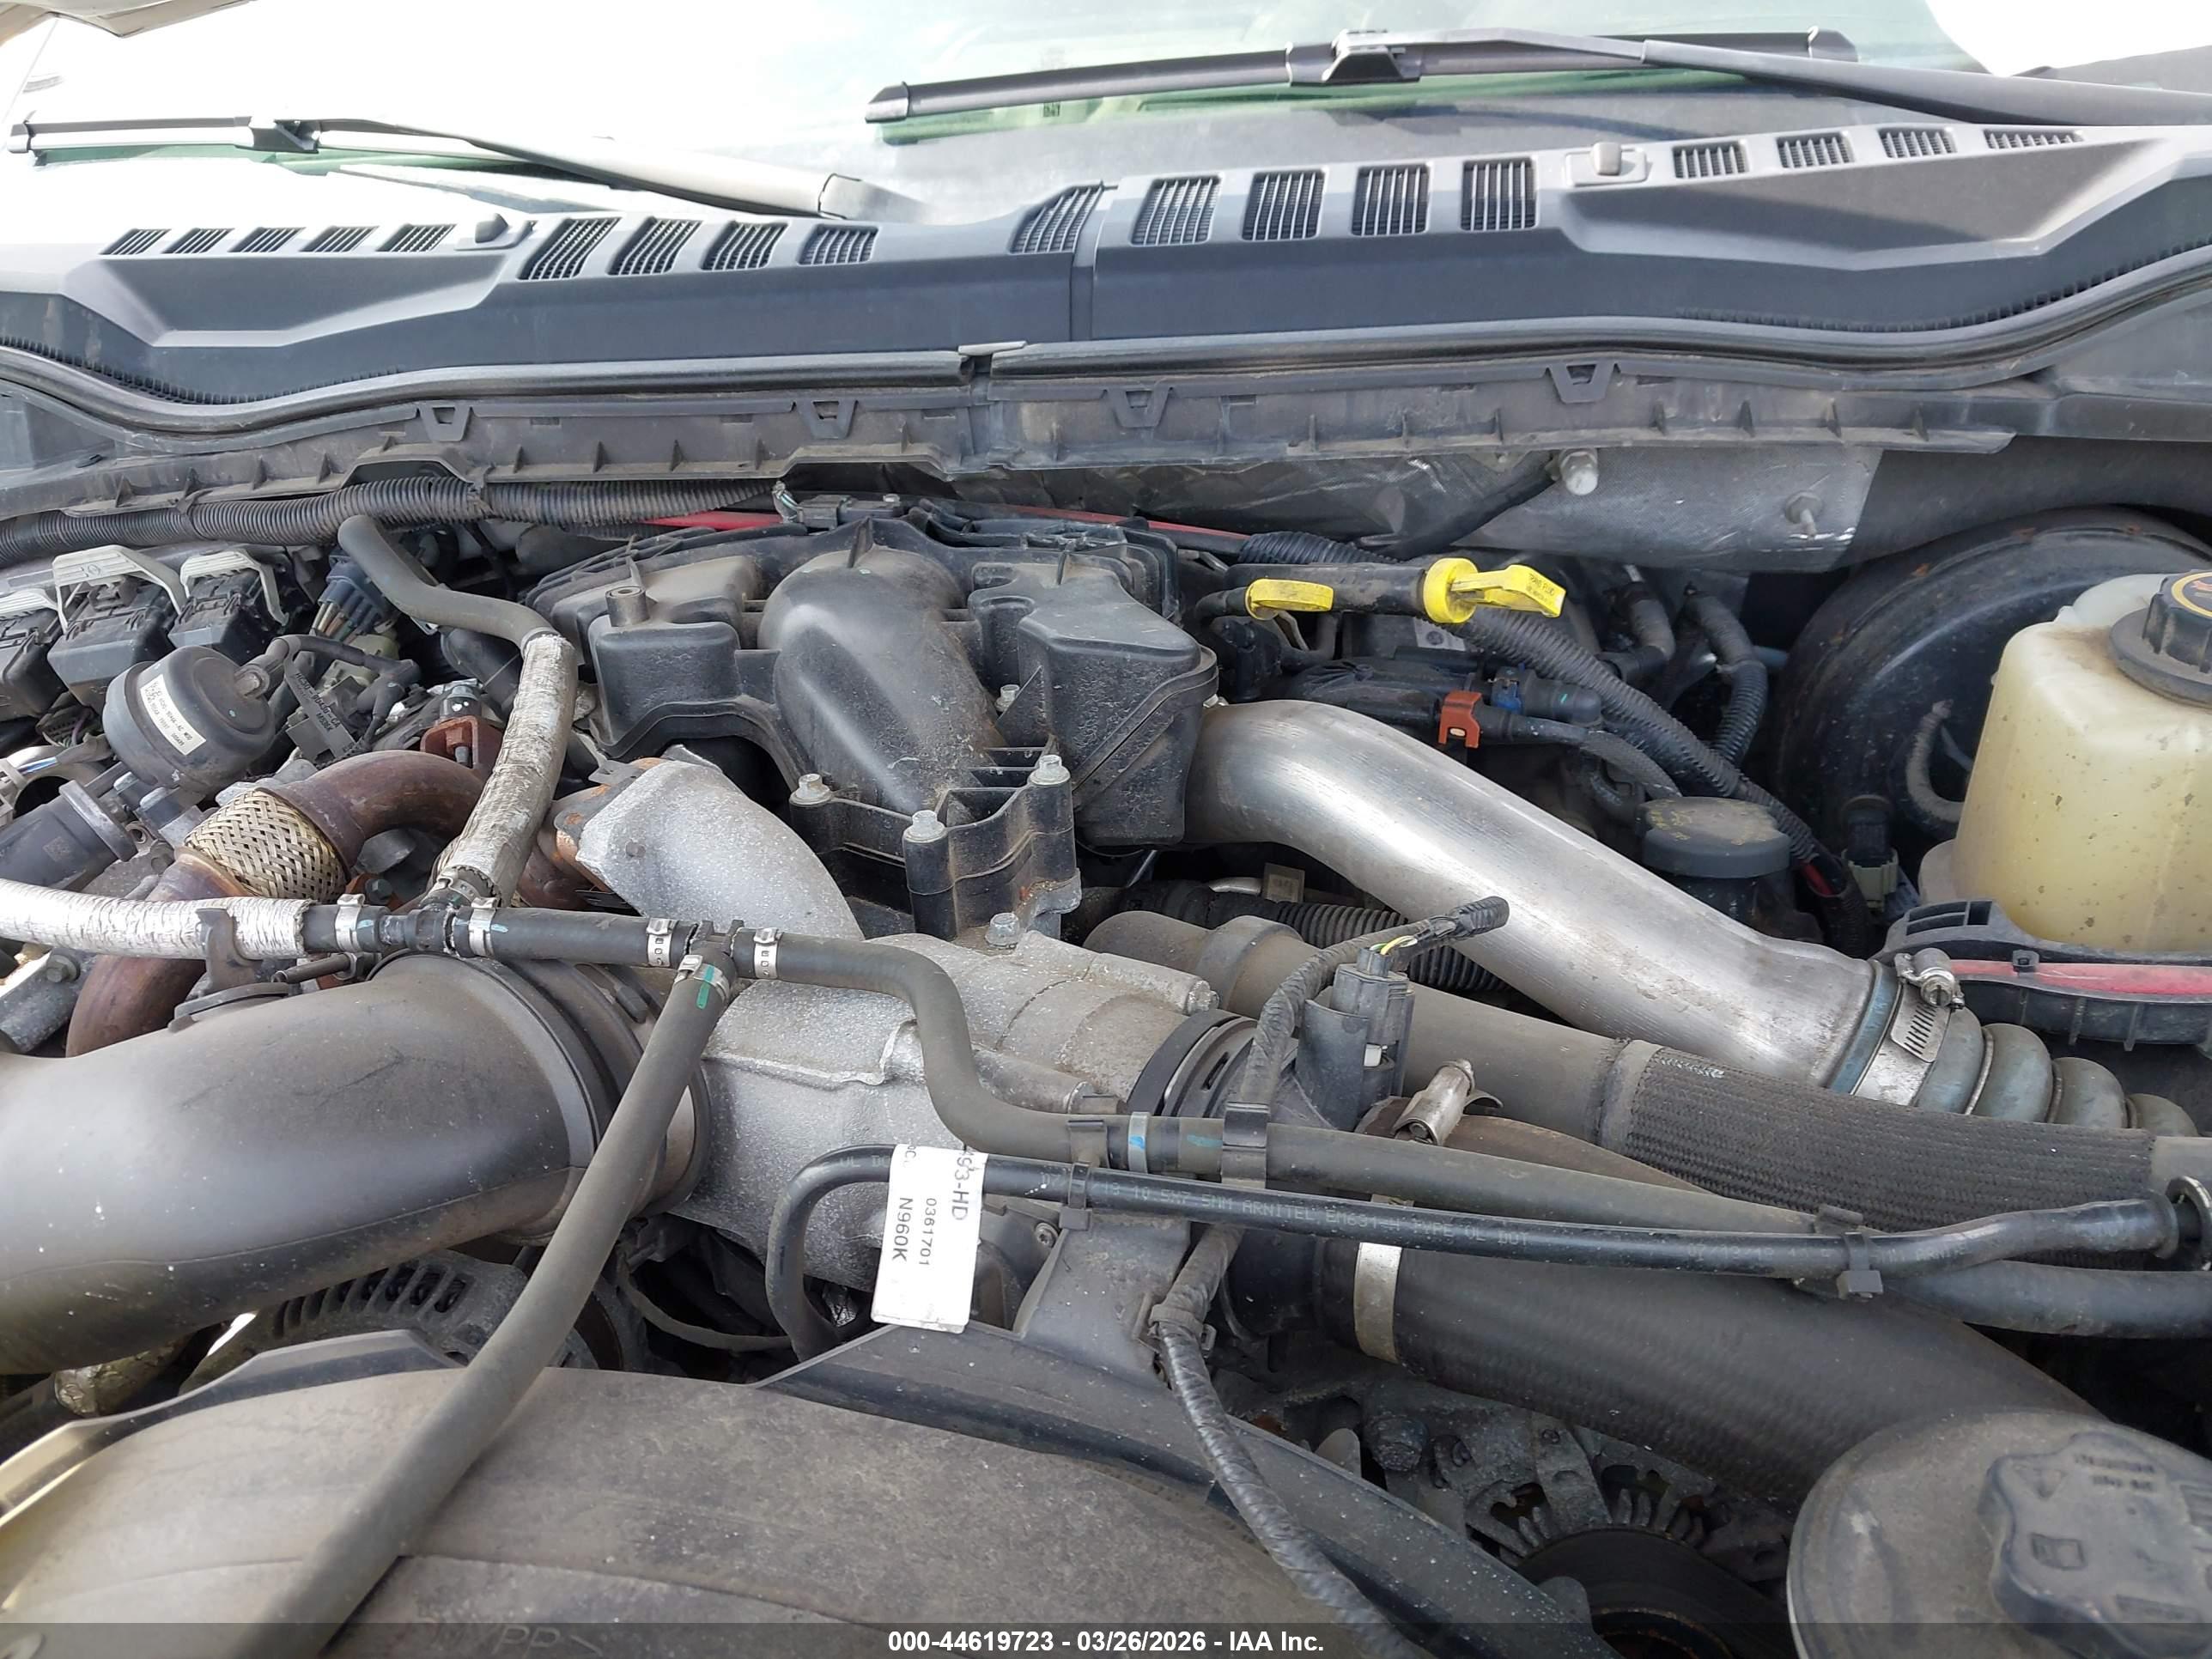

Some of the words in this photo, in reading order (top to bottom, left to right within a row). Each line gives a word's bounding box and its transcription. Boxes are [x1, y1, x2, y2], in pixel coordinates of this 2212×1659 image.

[891, 1196, 914, 1262] N960K
[918, 1197, 938, 1266] 0361701
[1242, 1199, 1316, 1221] ARNITEL
